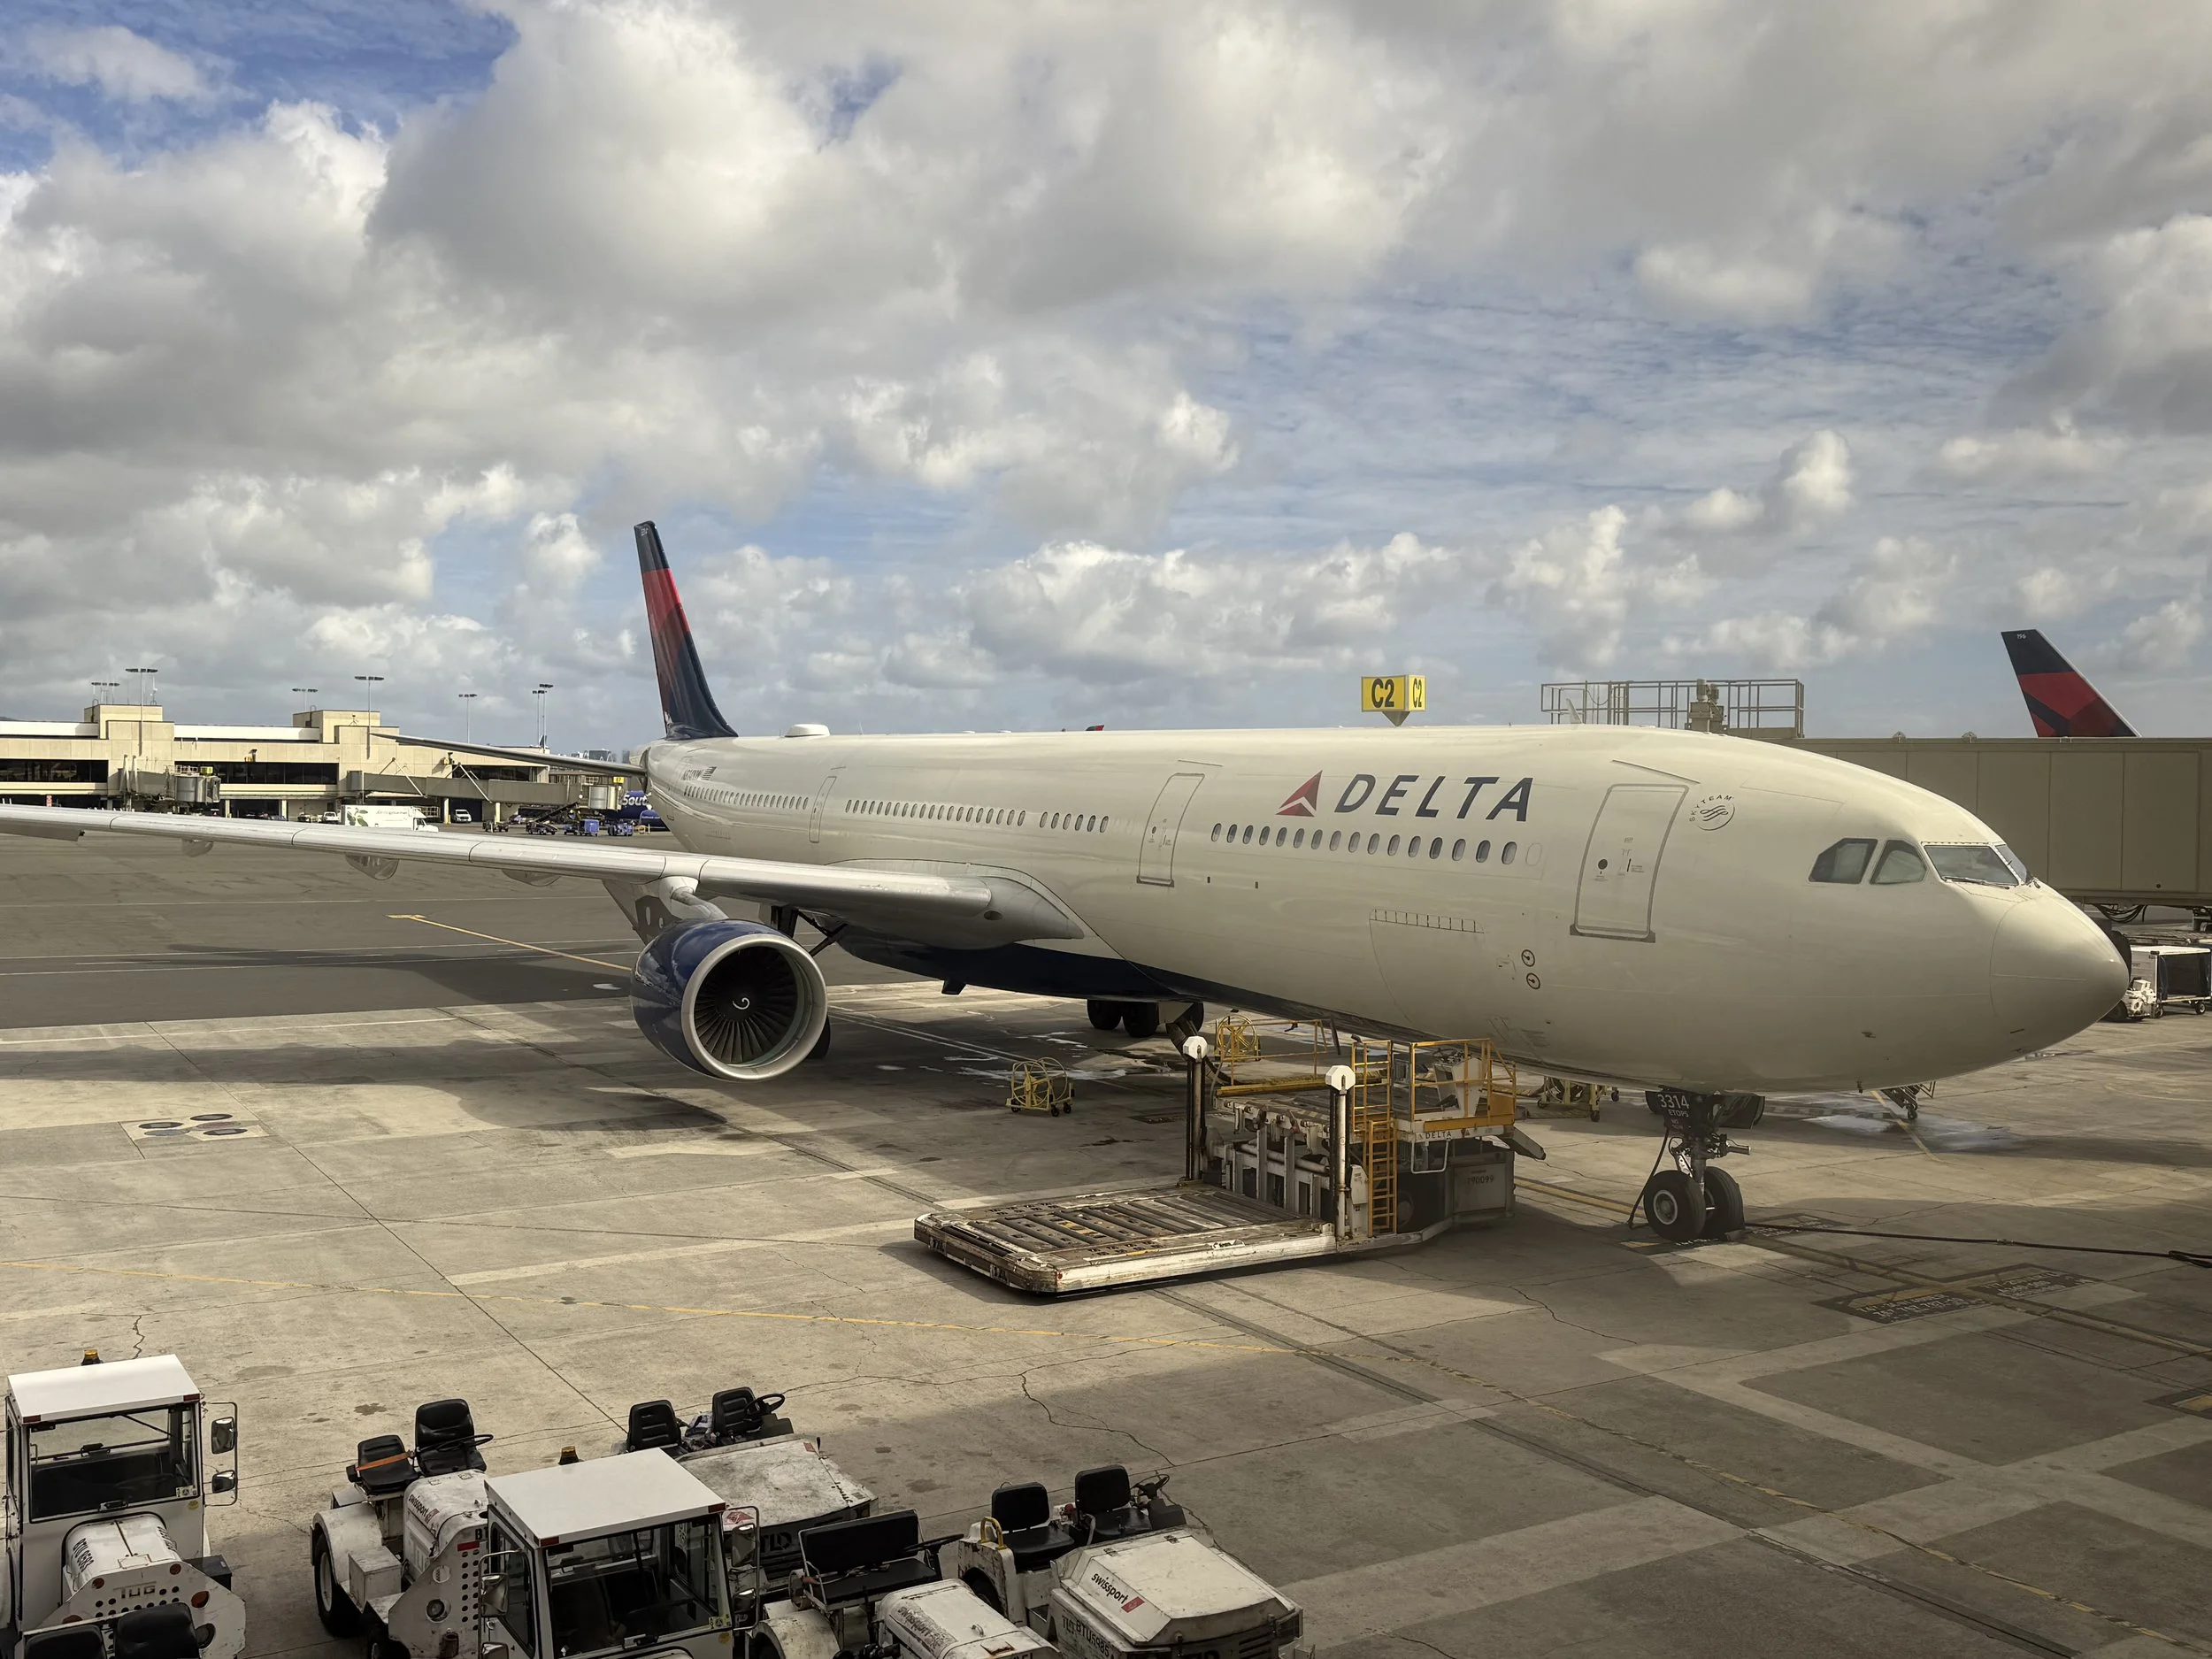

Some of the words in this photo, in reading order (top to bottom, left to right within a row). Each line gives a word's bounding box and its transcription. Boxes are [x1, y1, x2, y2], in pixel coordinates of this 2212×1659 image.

[1371, 678, 1394, 708] C2
[1413, 678, 1422, 708] C2
[1334, 774, 1533, 822] DELTA
[1689, 795, 1732, 822] SKYTEAM
[1657, 1094, 1689, 1109] 3314
[1668, 1109, 1689, 1118] ETOPS
[1425, 1131, 1451, 1140] DELTA
[409, 1494, 430, 1517] swissport
[113, 1581, 157, 1600] TUG
[1091, 1573, 1129, 1604] swissport
